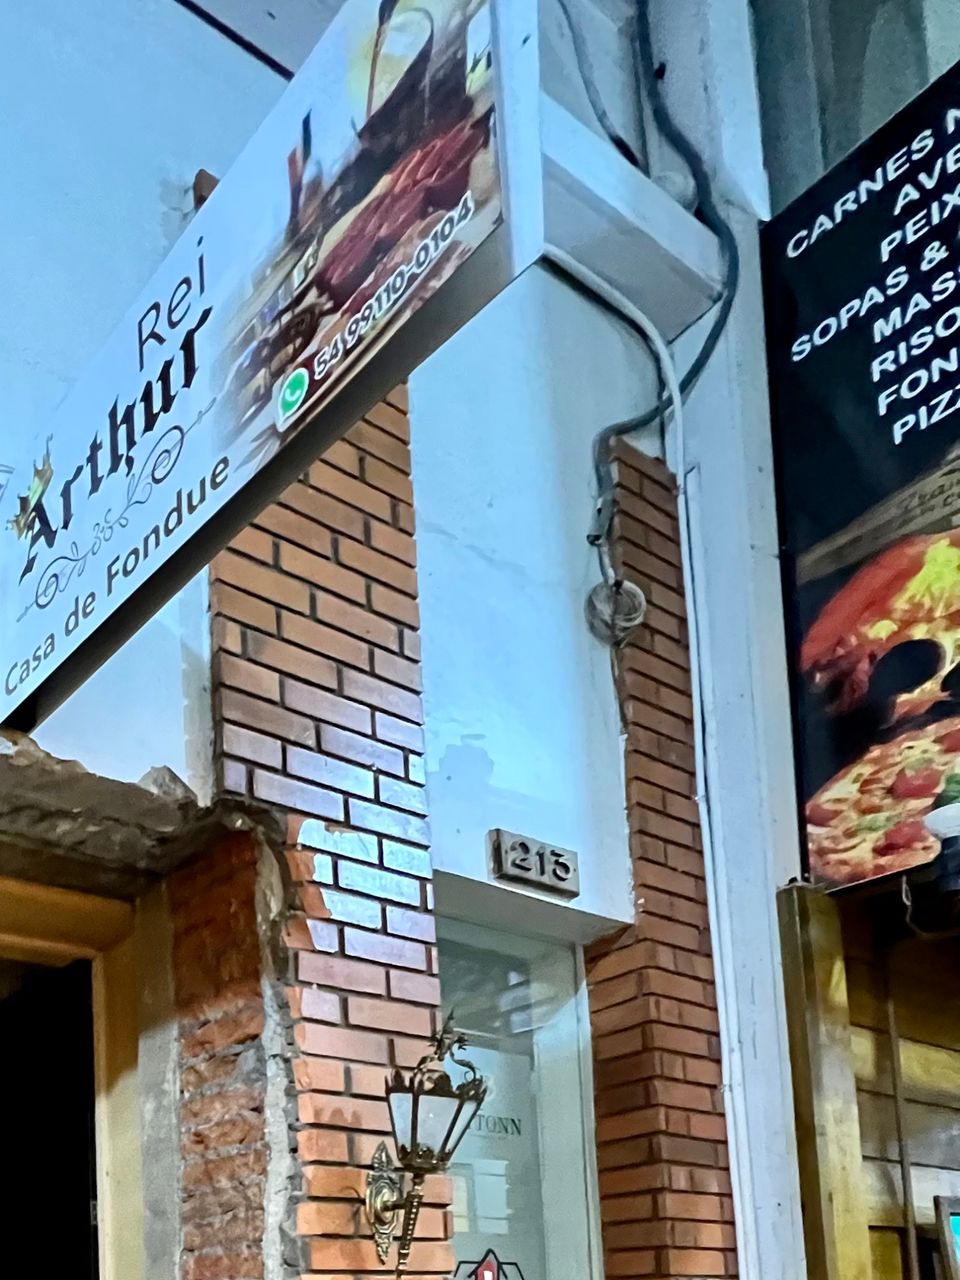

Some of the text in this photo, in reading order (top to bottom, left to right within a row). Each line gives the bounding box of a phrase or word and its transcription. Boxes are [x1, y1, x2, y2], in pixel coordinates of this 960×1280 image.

[786, 128, 935, 258] CARNES
[137, 236, 205, 372] Rei
[791, 241, 950, 362] SOPAS &
[873, 268, 960, 344] MAS
[314, 335, 342, 379] 54
[877, 347, 959, 416] FON
[18, 304, 214, 586] Arthur
[4, 455, 230, 696] Casa de Fondue
[509, 840, 572, 882] 215
[467, 1112, 522, 1137] TONN
